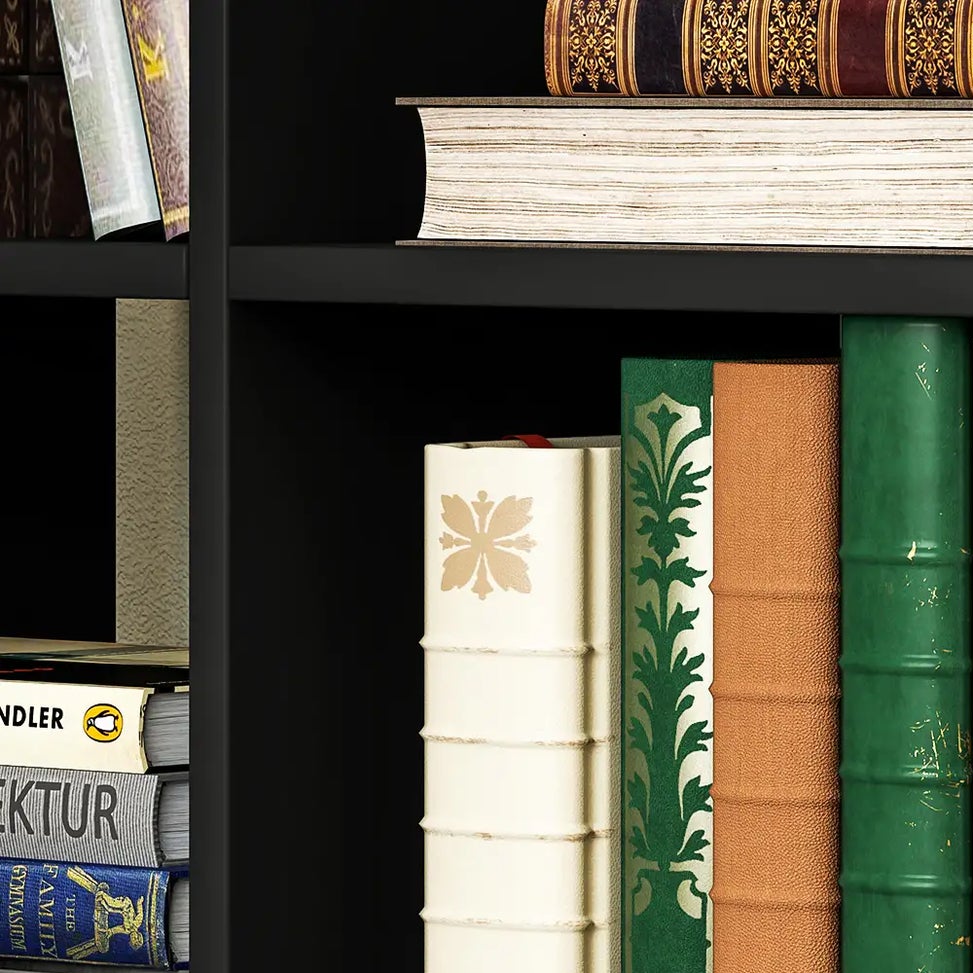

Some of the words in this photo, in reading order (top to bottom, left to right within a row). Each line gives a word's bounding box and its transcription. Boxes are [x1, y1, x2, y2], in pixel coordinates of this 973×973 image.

[0, 704, 64, 730] NDLER
[9, 865, 28, 951] GYMNASIUM
[39, 864, 58, 958] FAMILY
[66, 894, 76, 932] THE
